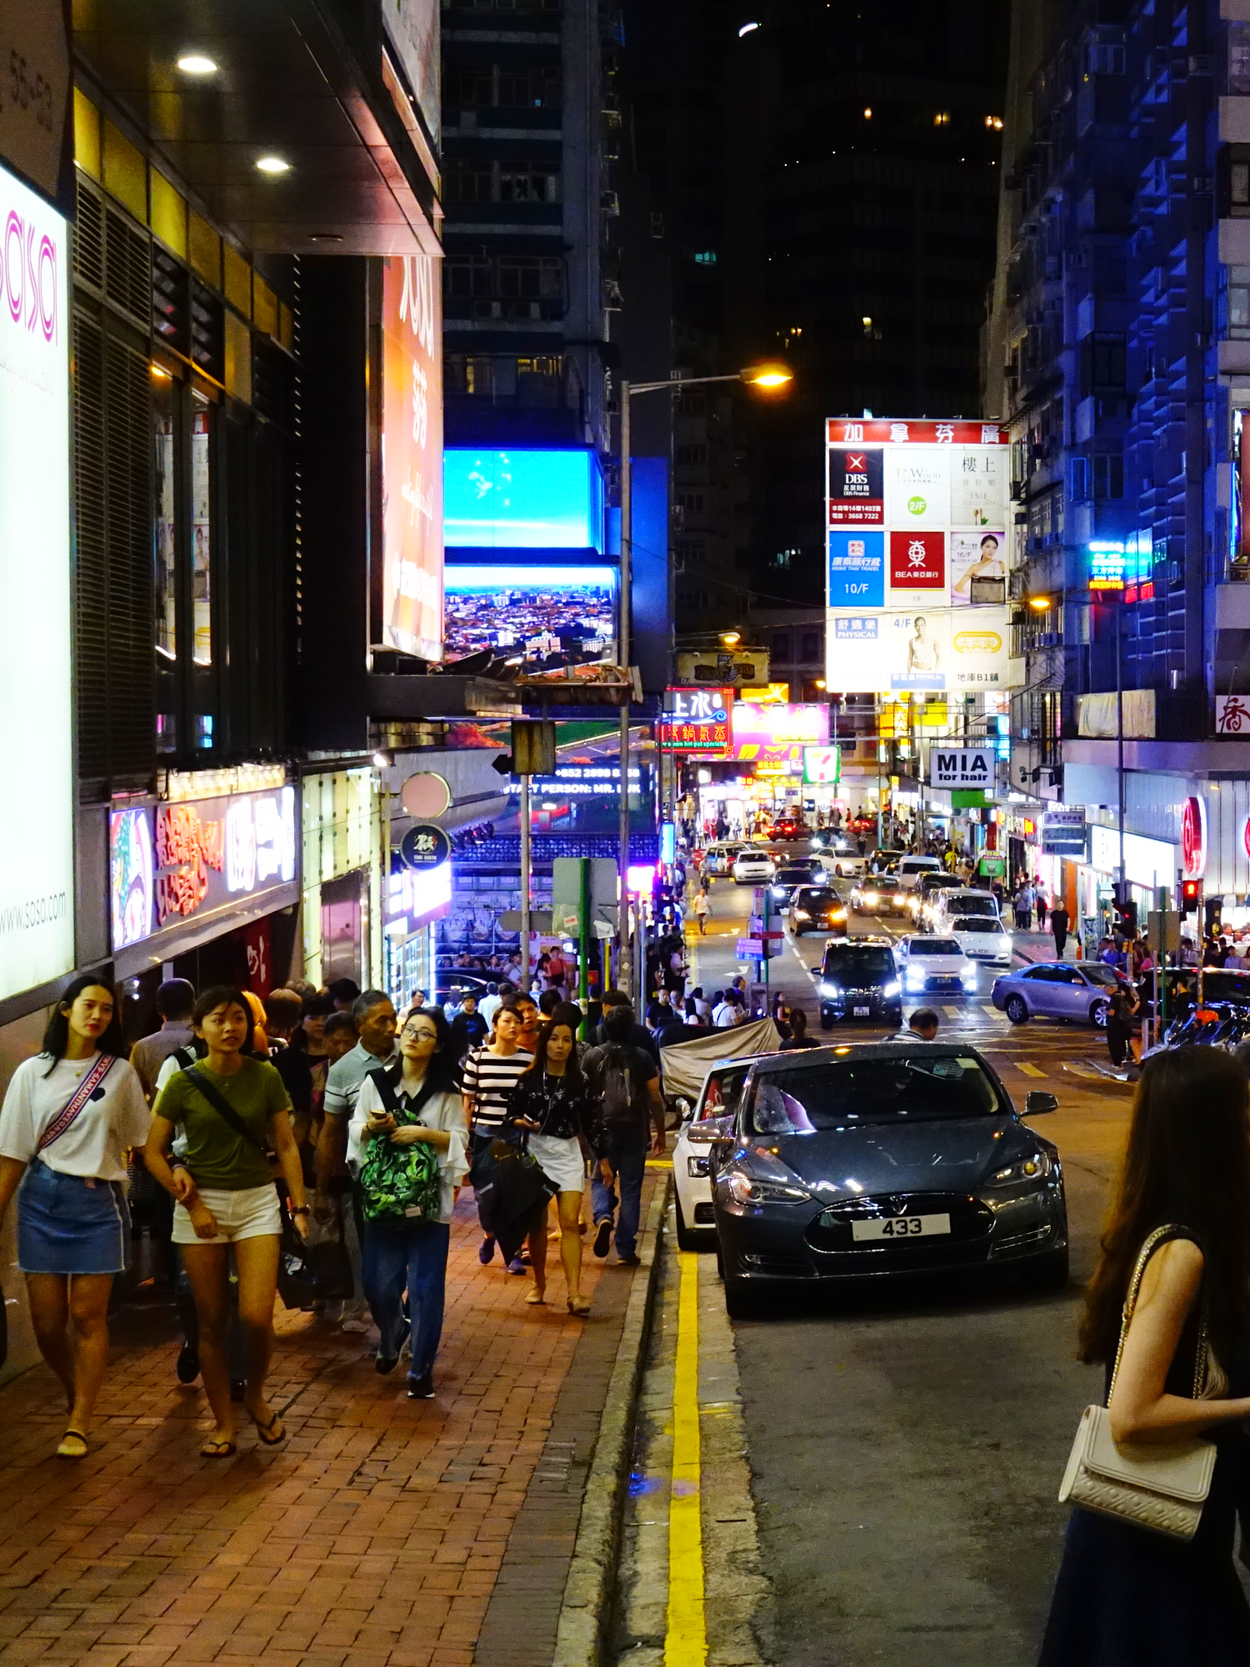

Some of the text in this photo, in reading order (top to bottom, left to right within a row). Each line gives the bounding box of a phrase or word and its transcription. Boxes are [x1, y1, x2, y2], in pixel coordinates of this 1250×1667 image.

[844, 423, 999, 443] 加拿芬廣
[962, 457, 995, 473] 樓上
[845, 473, 867, 484] DBS
[909, 501, 925, 511] 2/F
[845, 584, 869, 594] 10/F
[894, 619, 911, 628] 4/F
[938, 755, 987, 771] MIA
[542, 784, 592, 793] PERSON:
[594, 784, 615, 793] MR.
[882, 1218, 922, 1236] 433
